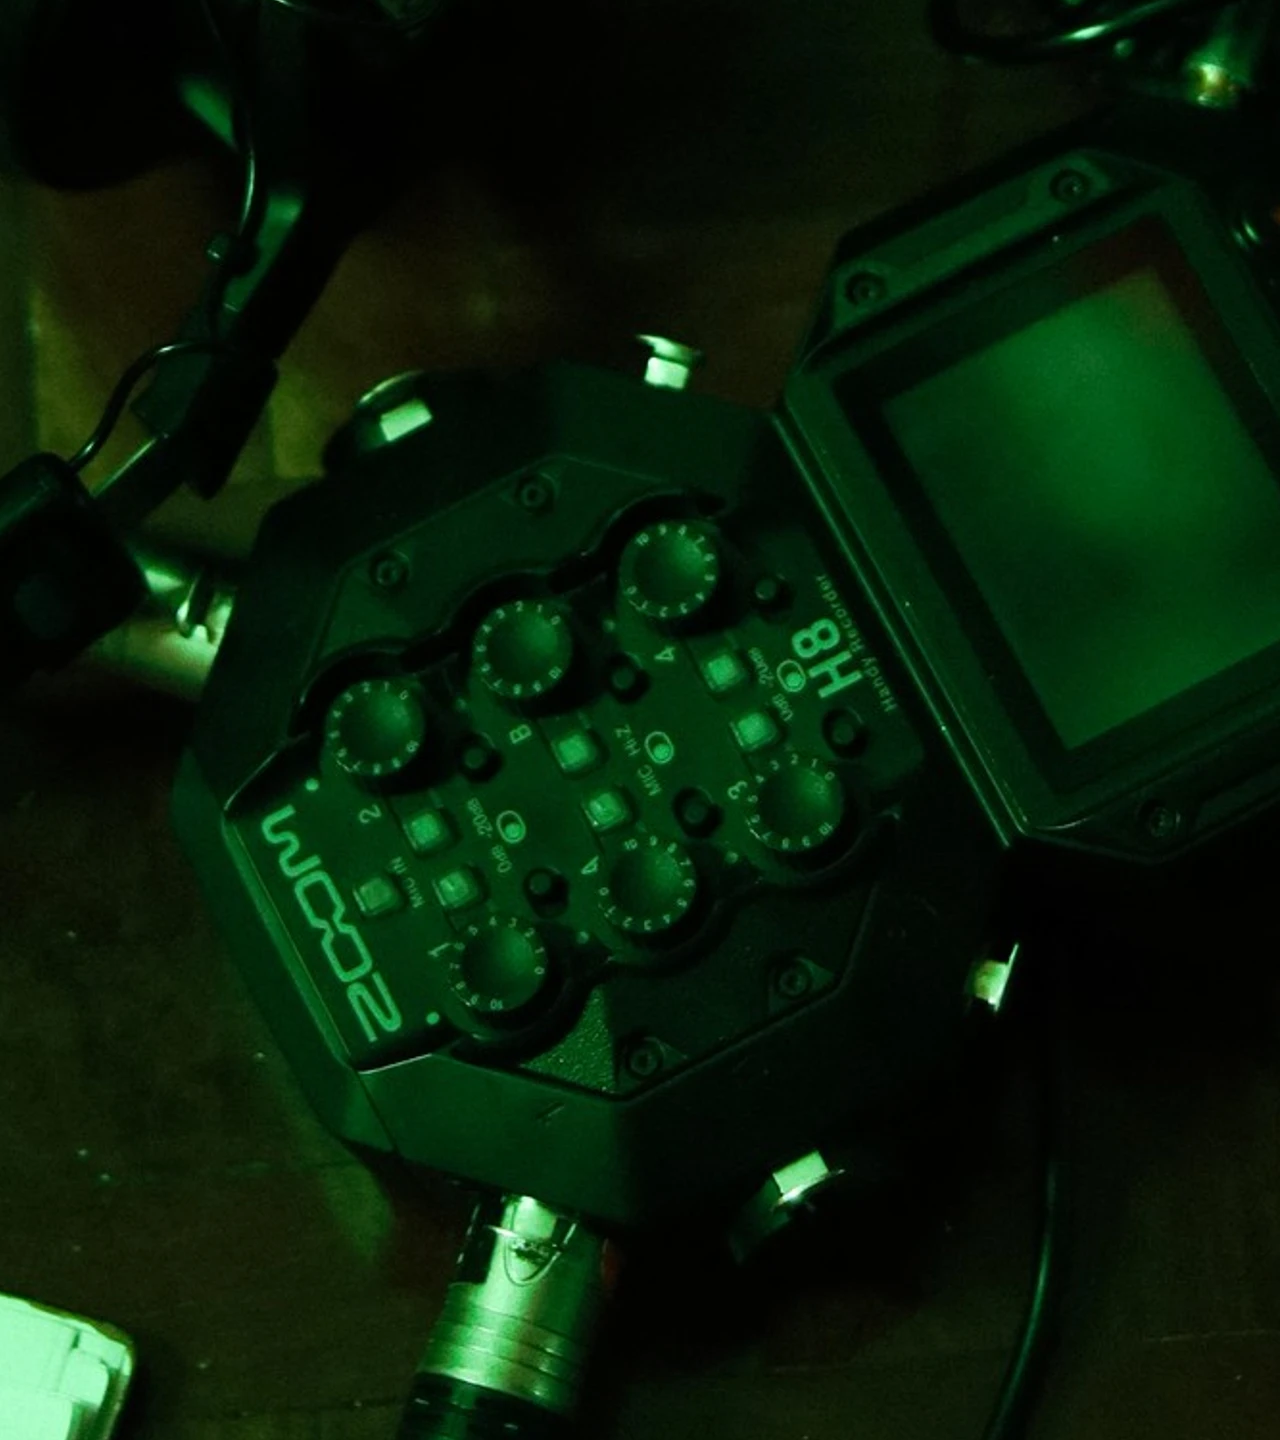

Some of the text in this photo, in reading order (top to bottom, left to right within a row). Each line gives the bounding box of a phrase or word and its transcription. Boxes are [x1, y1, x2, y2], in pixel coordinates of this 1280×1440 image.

[815, 574, 898, 713] Handy Recorder
[653, 646, 675, 663] 4
[791, 618, 863, 699] H8
[509, 723, 532, 745] B
[614, 723, 662, 797] MIC Hi-Z
[727, 780, 748, 800] 3
[358, 803, 382, 824] 2
[581, 855, 600, 875] A
[260, 804, 403, 1043] ZOOM
[427, 942, 452, 958] 1
